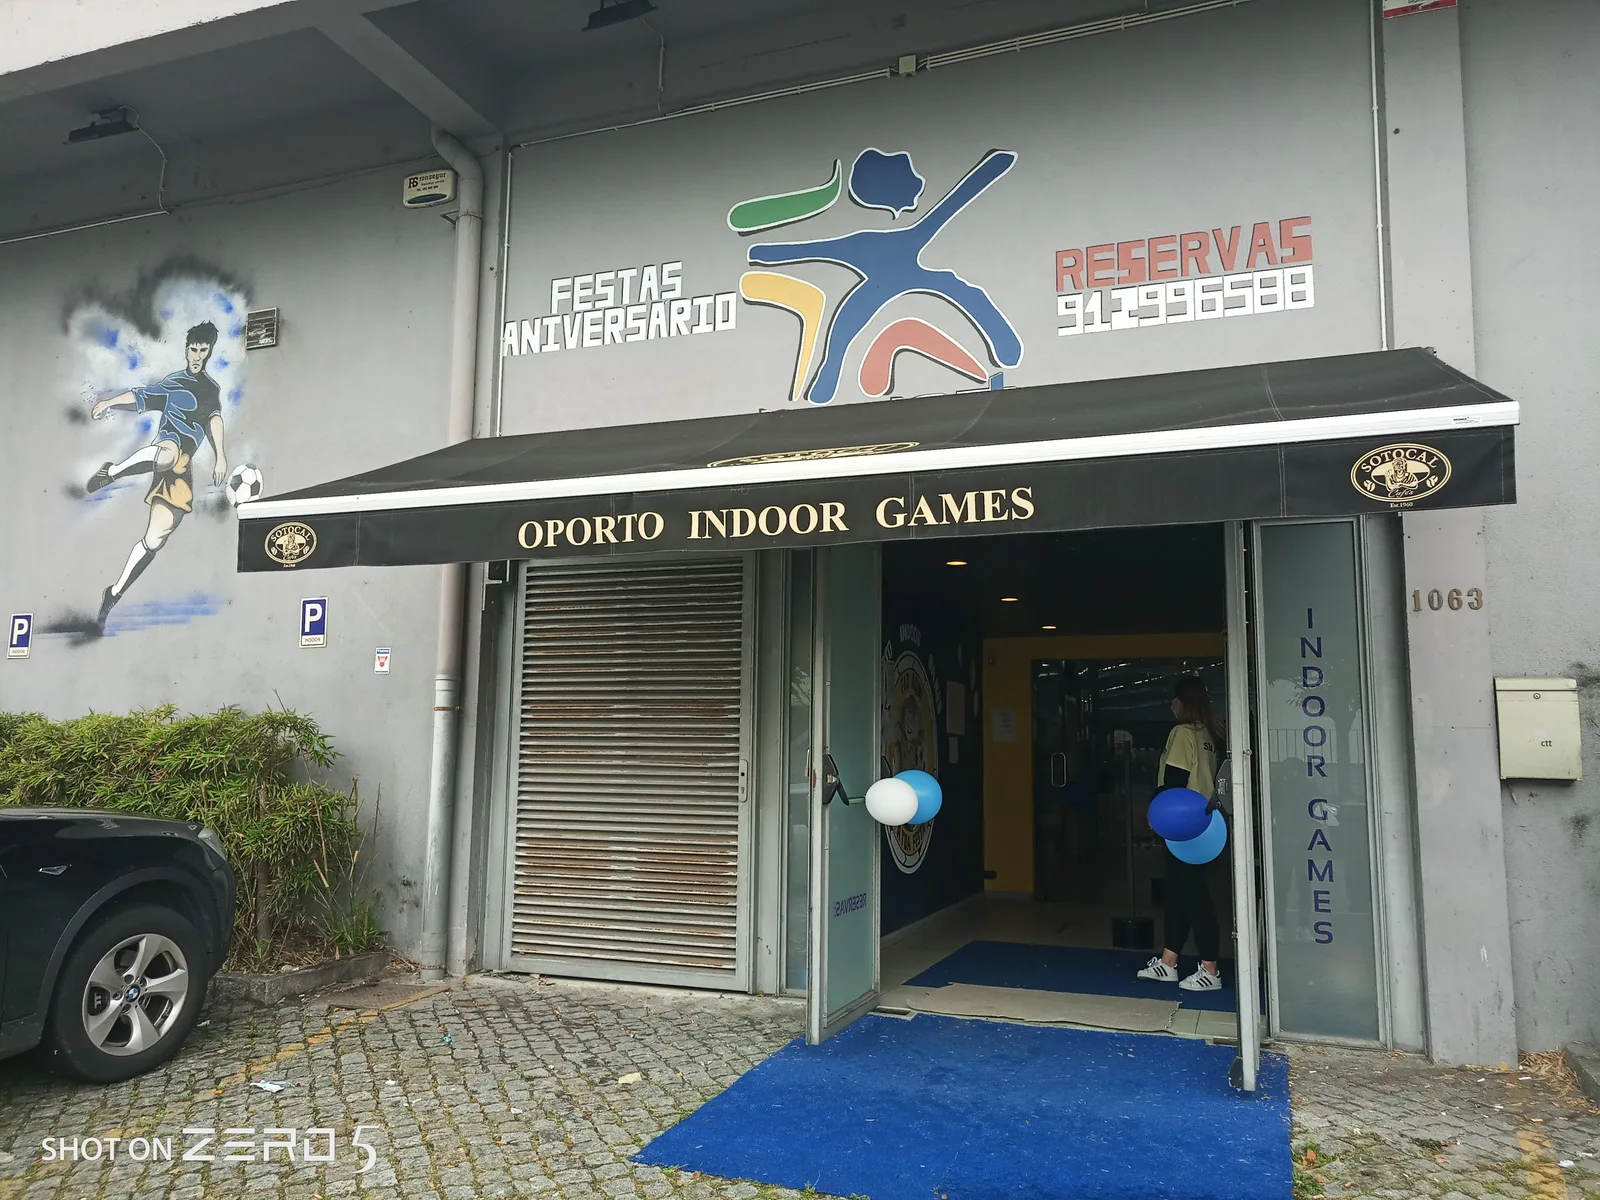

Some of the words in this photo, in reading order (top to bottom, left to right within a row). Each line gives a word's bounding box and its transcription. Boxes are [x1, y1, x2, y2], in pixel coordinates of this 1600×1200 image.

[1056, 216, 1313, 292] RESERVAS
[551, 261, 682, 315] FESTAS
[1057, 264, 1315, 337] 912996588
[1361, 448, 1440, 473] SOTOCAL
[271, 526, 311, 542] SOTOCAL
[518, 511, 665, 549] OPORTO
[687, 502, 849, 539] INDOOR
[875, 487, 1035, 528] GAMES
[304, 603, 323, 633] P
[1412, 587, 1484, 612] 1063
[12, 618, 29, 645] P
[1300, 608, 1327, 778] INDOOR
[1307, 798, 1334, 945] GAMES
